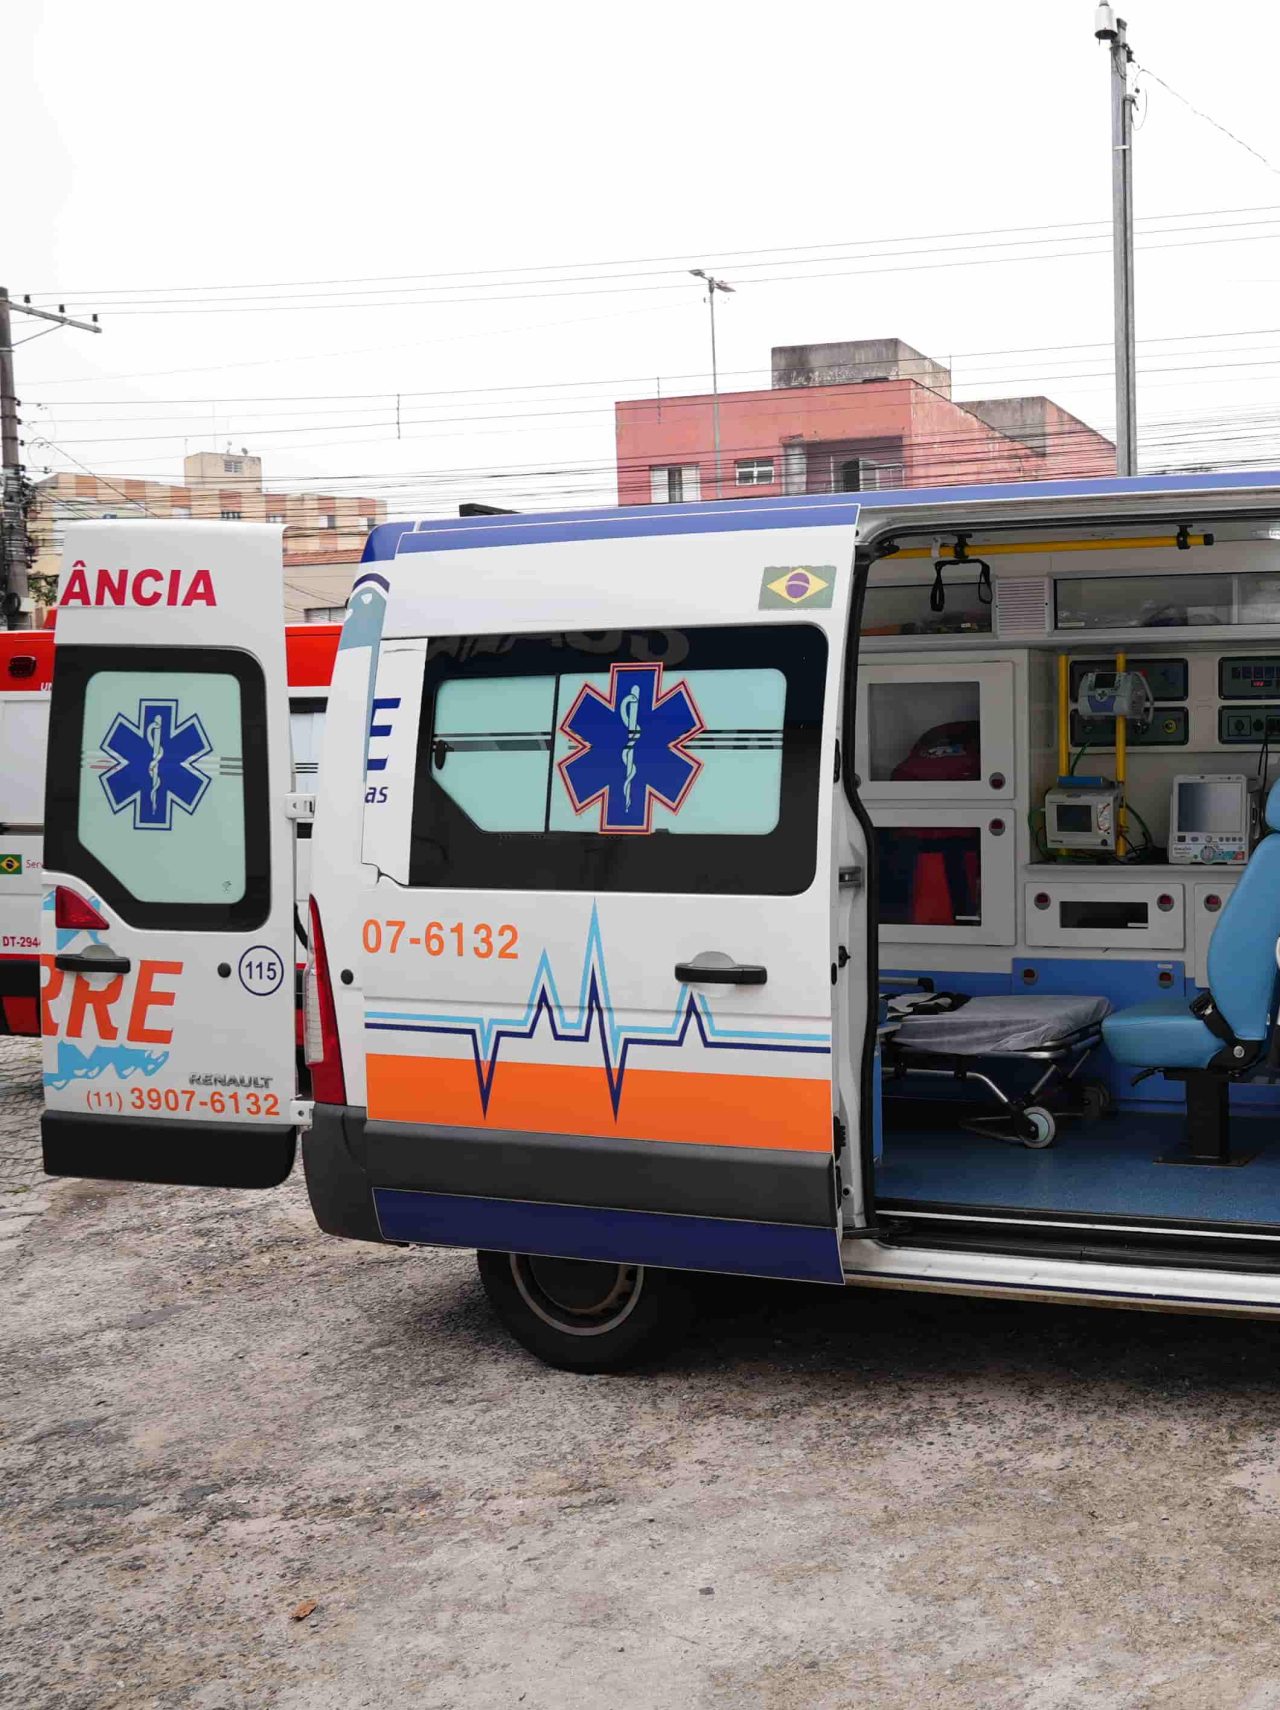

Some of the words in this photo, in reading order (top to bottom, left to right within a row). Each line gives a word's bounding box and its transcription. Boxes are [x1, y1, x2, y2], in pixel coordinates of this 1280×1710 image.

[59, 560, 217, 607] ÂNCIA
[364, 786, 389, 803] as
[2, 936, 41, 948] DT-294
[362, 919, 520, 960] 07-6132
[245, 961, 277, 981] 115
[188, 1074, 273, 1089] RENAULT
[86, 1090, 123, 1113] (11)
[130, 1087, 281, 1116] 3907-6132
